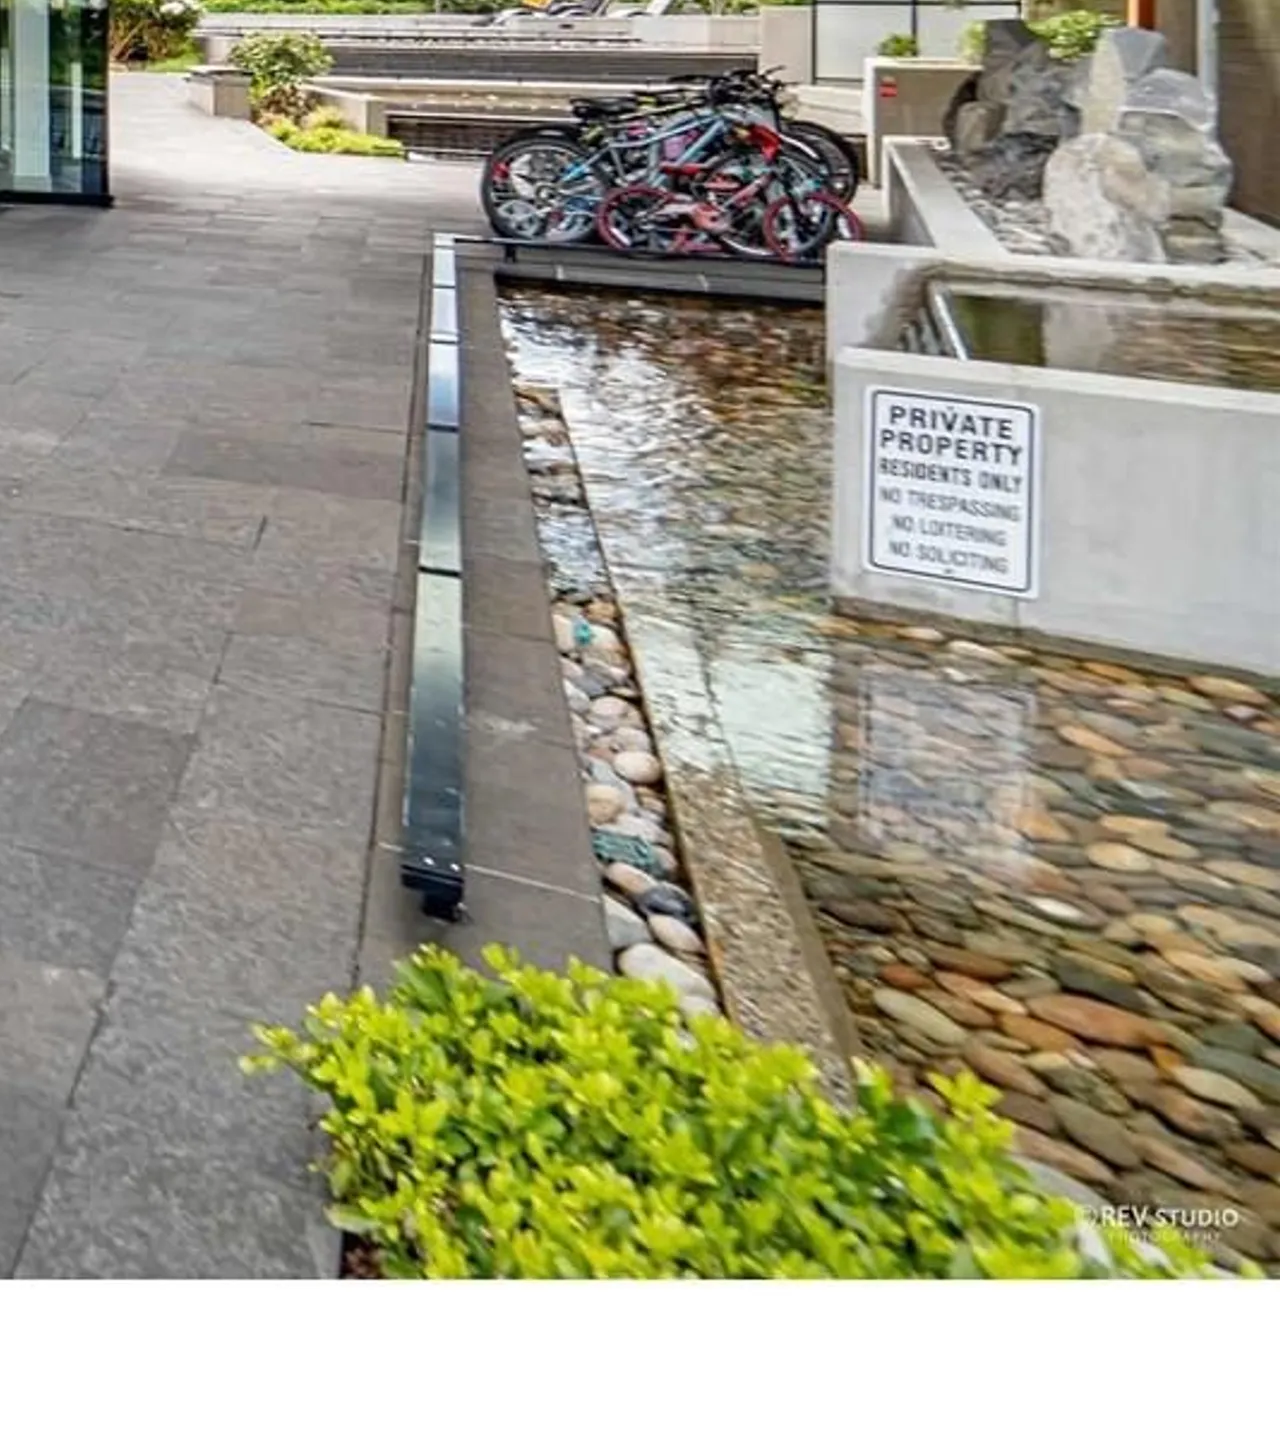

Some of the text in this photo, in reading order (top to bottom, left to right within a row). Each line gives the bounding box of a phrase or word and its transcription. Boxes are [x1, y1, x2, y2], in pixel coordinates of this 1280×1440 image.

[890, 406, 1013, 440] PRIVATE
[880, 429, 1022, 465] PROPERTY
[879, 458, 1023, 493] RESIDENTS ONLY
[880, 487, 1021, 521] NO TRESPASSING
[894, 517, 1007, 546] NO LOITERING
[890, 541, 1008, 574] NO SOLICITING
